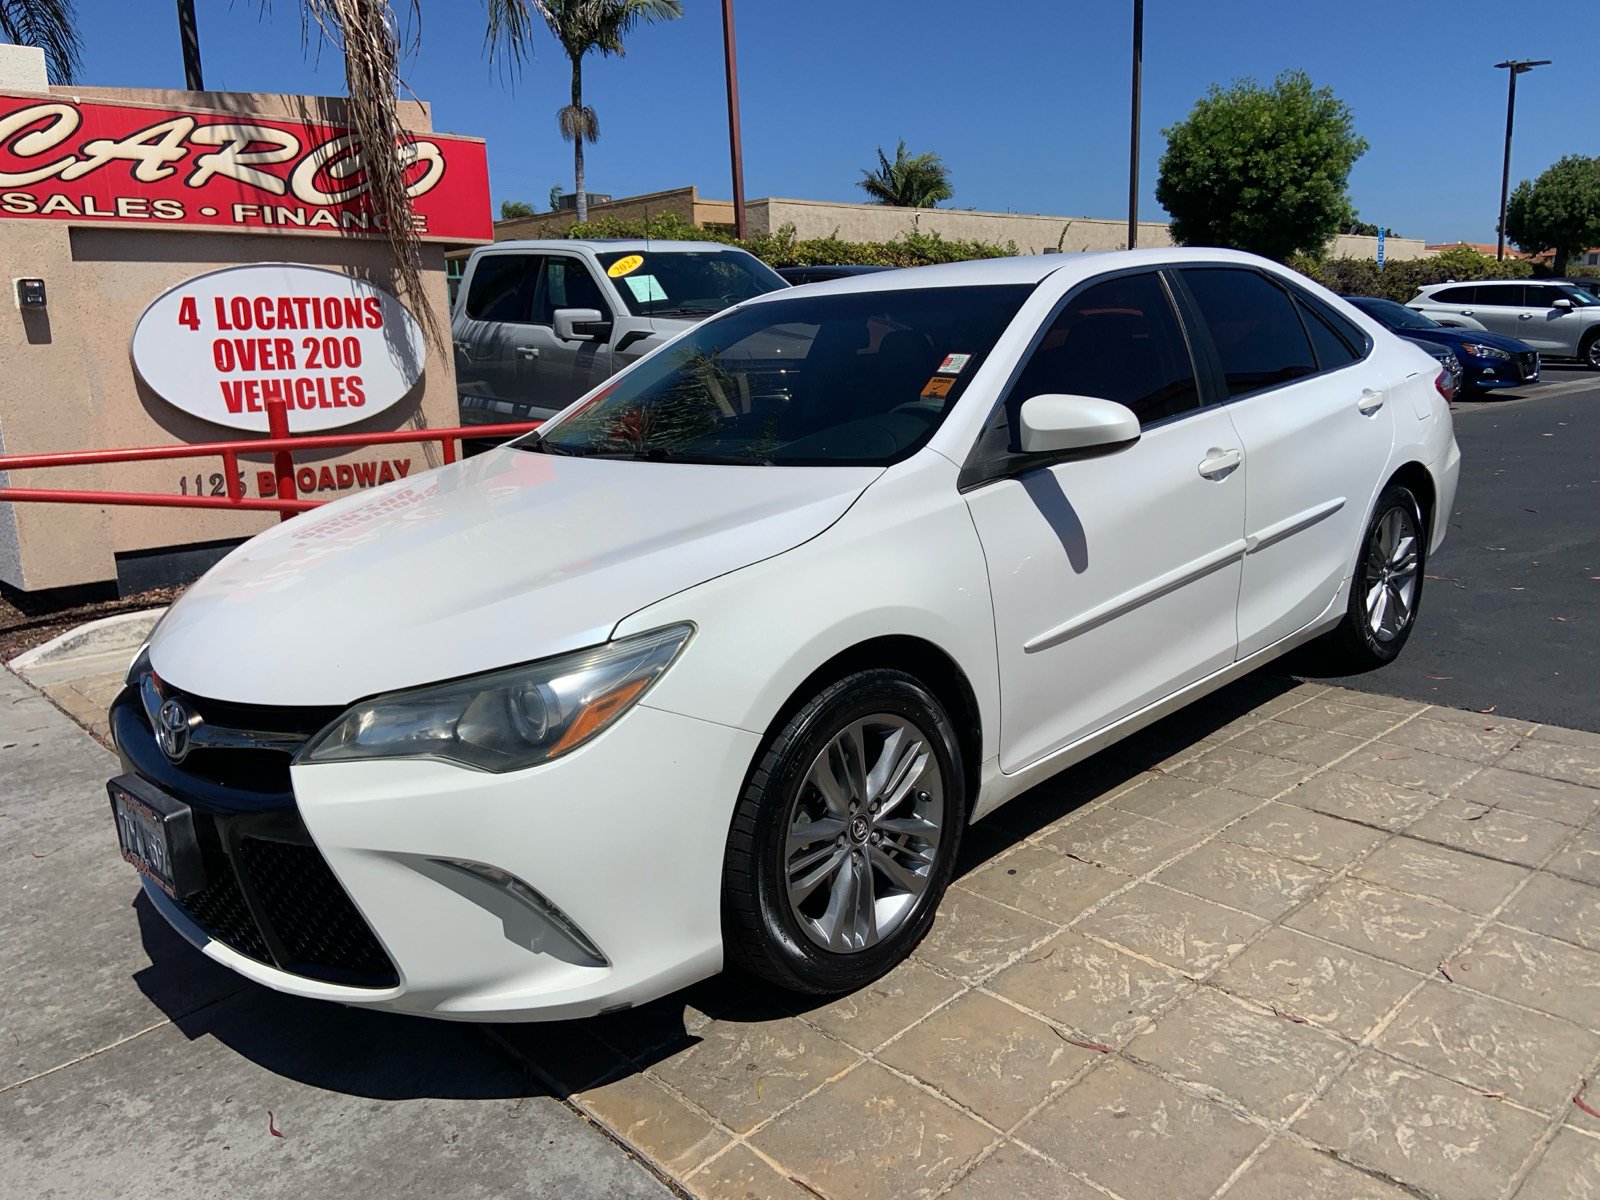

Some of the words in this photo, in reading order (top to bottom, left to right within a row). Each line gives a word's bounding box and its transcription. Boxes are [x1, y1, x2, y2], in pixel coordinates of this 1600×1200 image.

[1, 191, 185, 220] SALES
[178, 297, 200, 331] 4
[214, 296, 384, 330] LOCATIONS
[212, 337, 296, 372] OVER
[302, 336, 362, 369] 200
[220, 375, 366, 413] VEHICLES
[256, 459, 411, 497] BOADWAY
